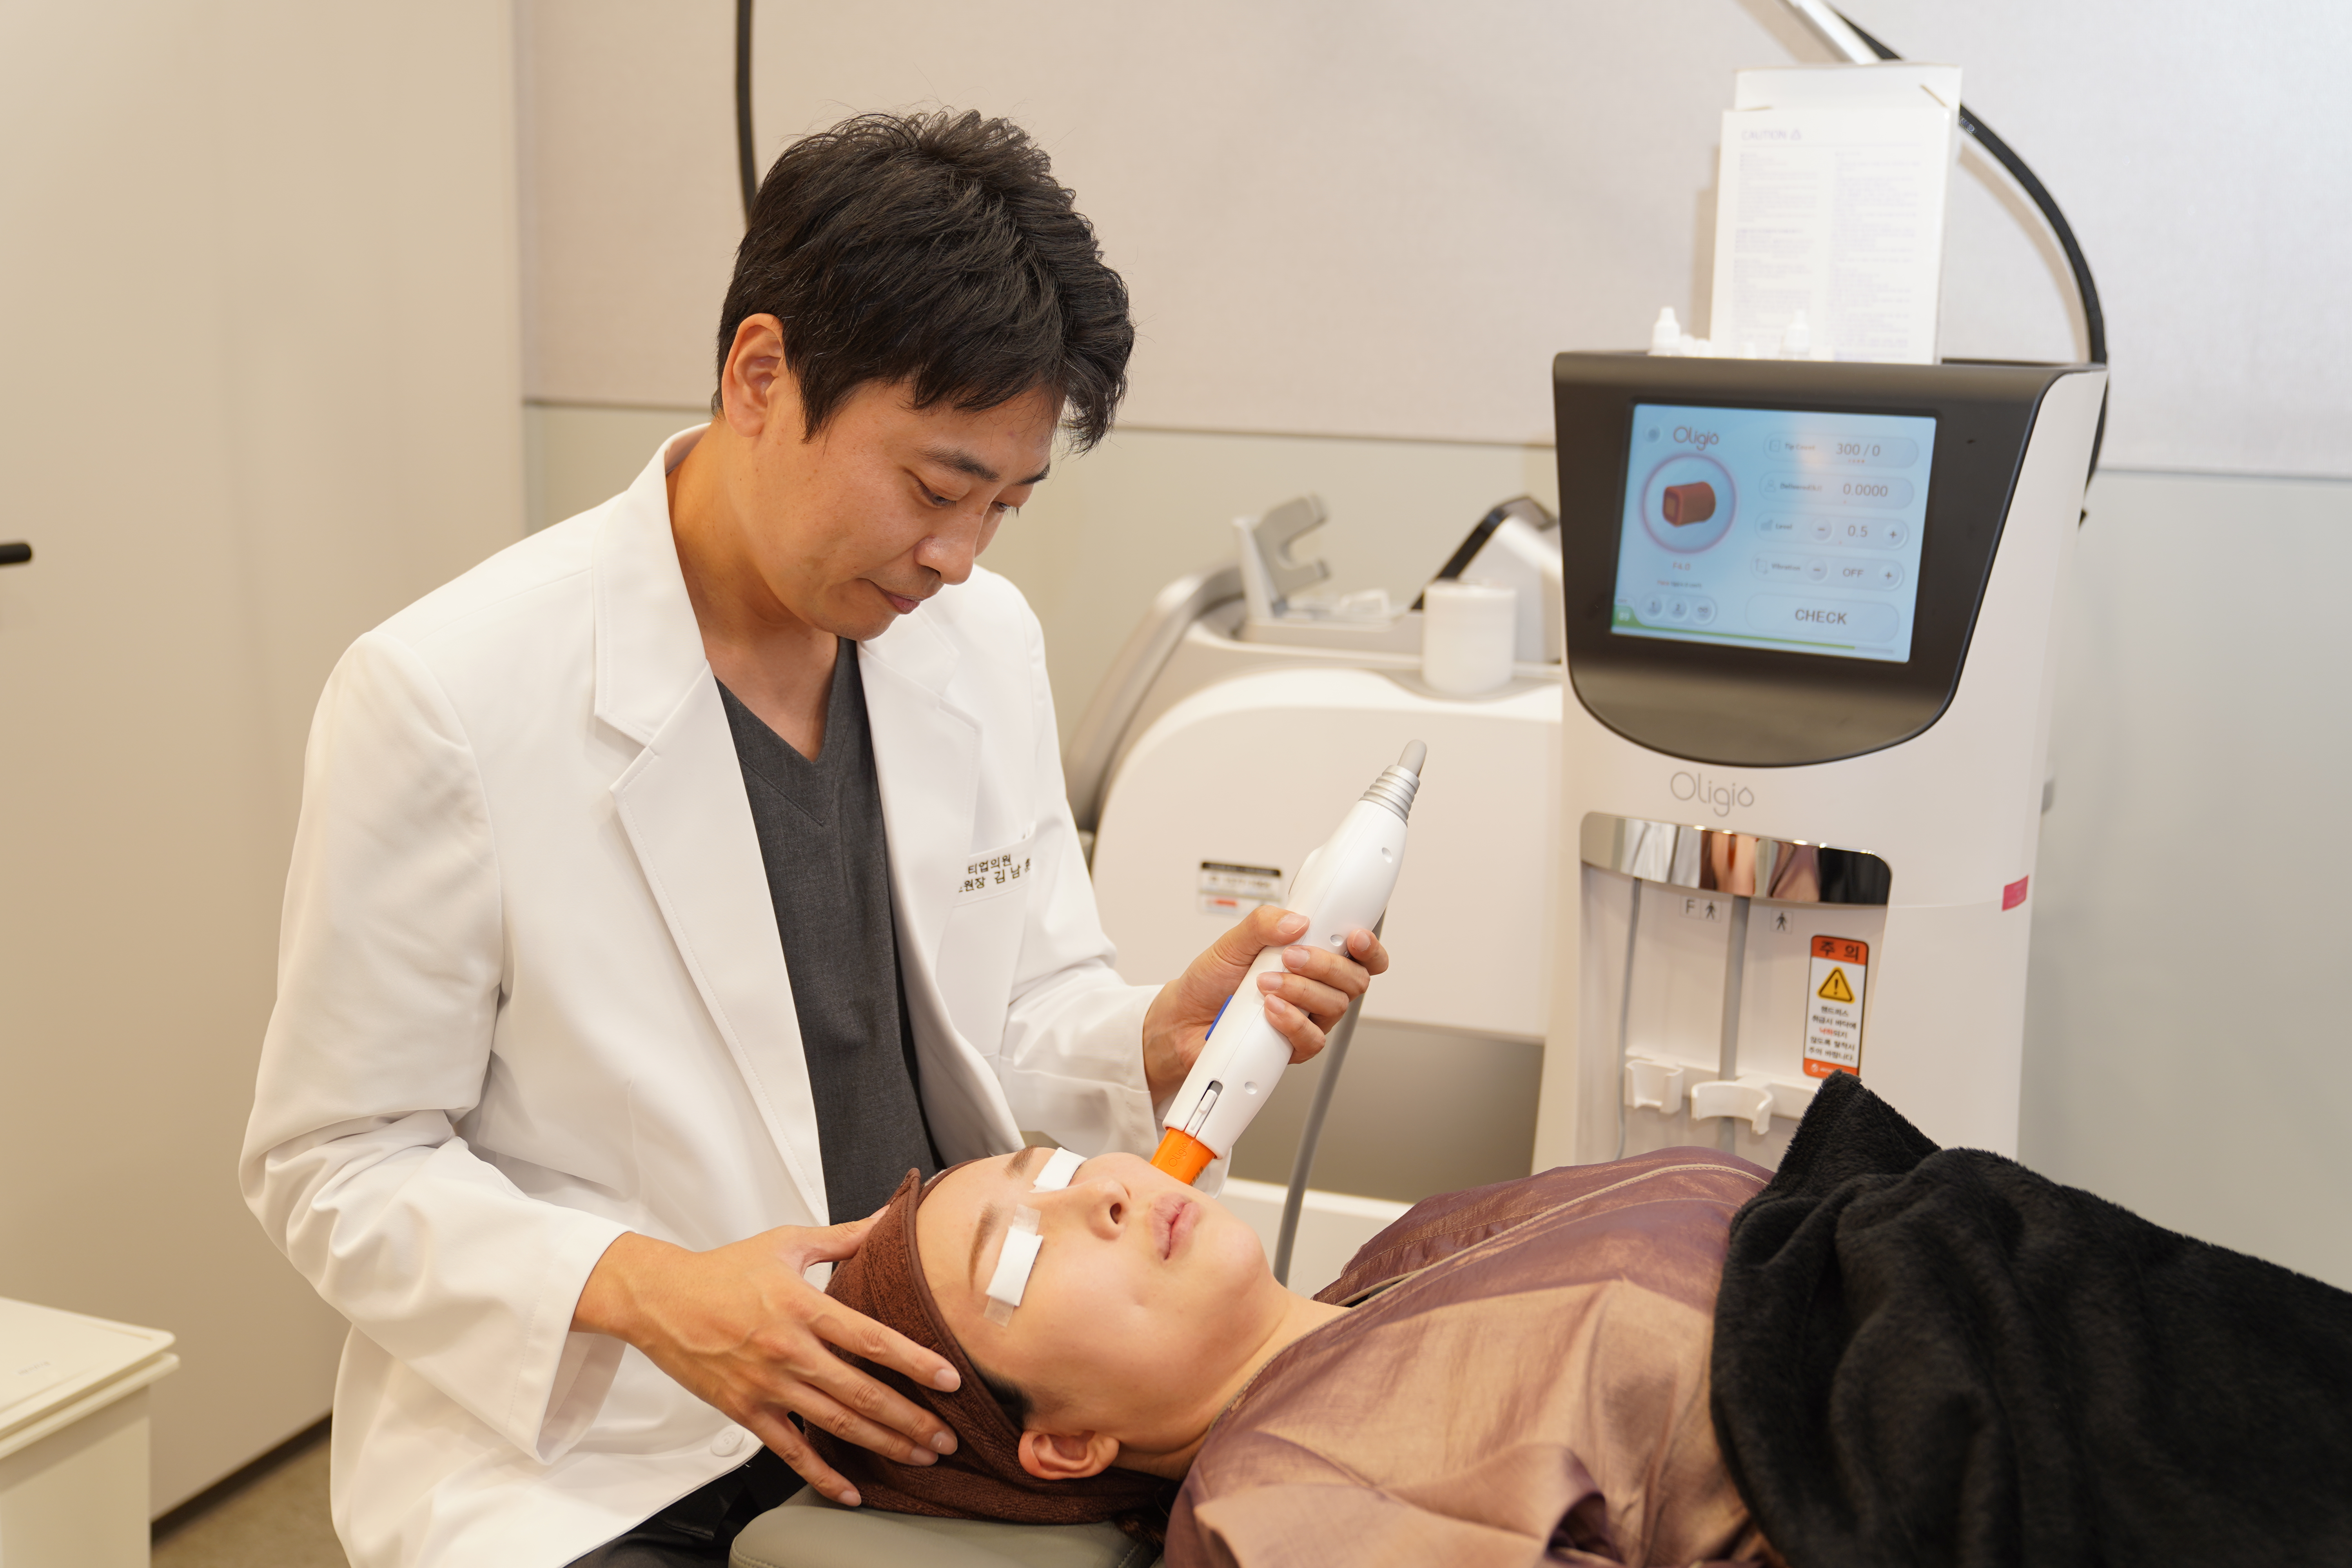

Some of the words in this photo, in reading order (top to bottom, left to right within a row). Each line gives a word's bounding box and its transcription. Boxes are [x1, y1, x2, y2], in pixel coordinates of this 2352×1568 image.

[1742, 130, 1787, 140] CAUTION
[1673, 426, 1719, 451] Oligio
[1836, 443, 1860, 456] 300
[1872, 445, 1880, 457] 0
[1843, 483, 1888, 497] 0.0000
[1848, 524, 1868, 537] 0.5
[1843, 568, 1864, 578] OFF
[1795, 609, 1847, 625] CHECK
[1670, 771, 1755, 817] Oligio
[968, 854, 1012, 875] 티업의원
[1686, 899, 1695, 915] F
[1169, 1142, 1188, 1167] Oligio
